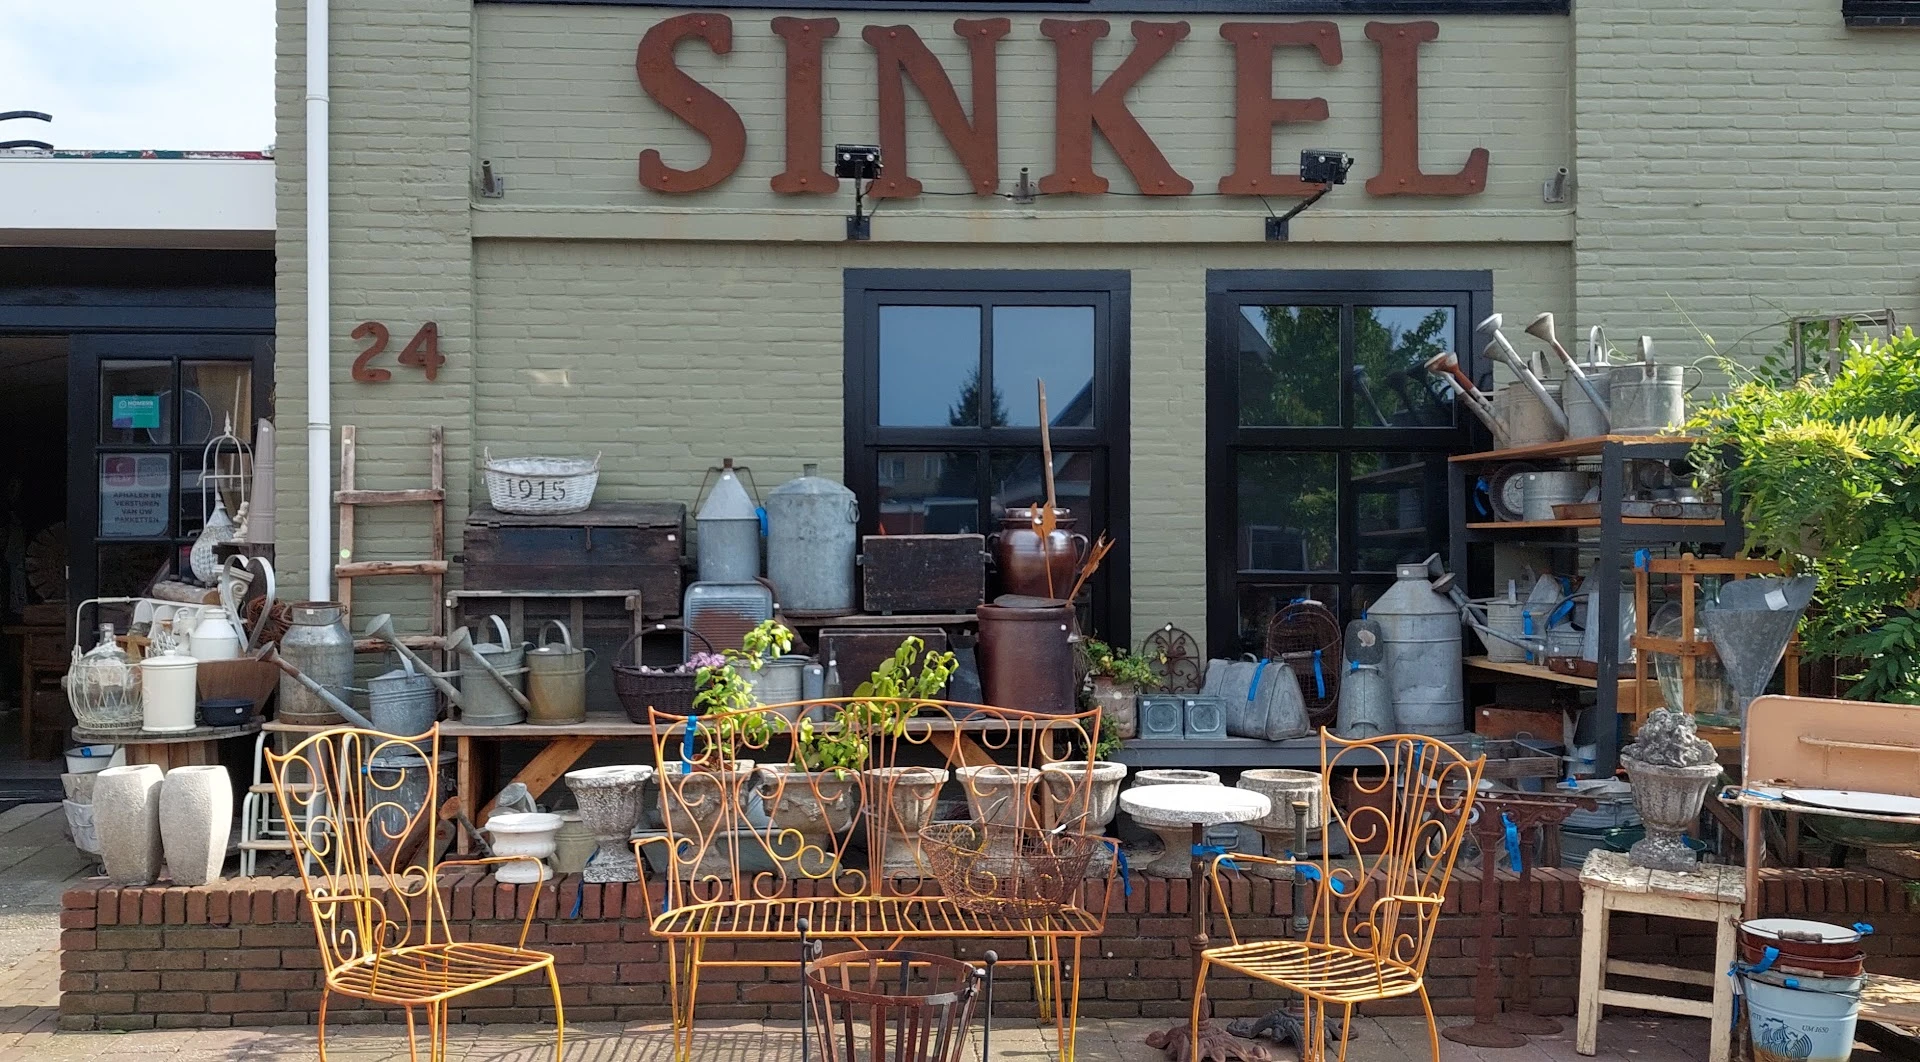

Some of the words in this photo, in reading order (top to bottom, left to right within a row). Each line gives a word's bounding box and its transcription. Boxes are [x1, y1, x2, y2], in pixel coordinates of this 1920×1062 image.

[636, 13, 1489, 198] SINKEL
[351, 322, 445, 380] 24
[505, 478, 566, 500] 1915
